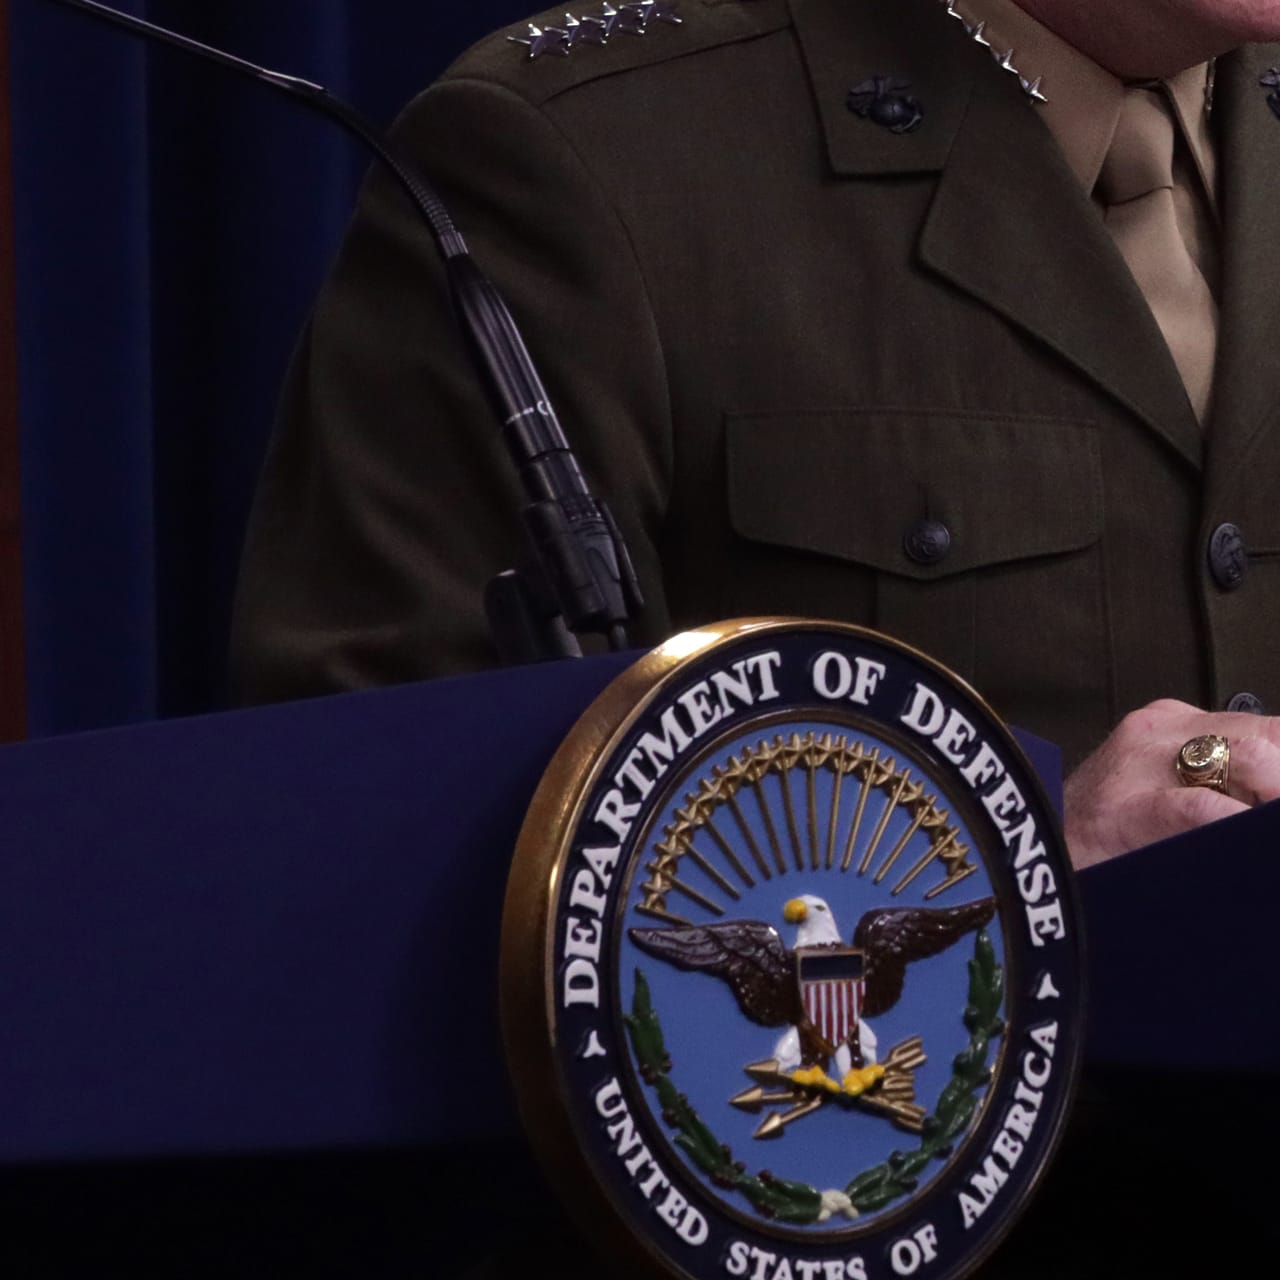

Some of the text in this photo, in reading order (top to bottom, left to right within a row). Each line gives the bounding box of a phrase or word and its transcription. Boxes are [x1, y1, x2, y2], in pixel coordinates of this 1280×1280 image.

[563, 650, 1065, 1008] DEPARTMENT OF DEFENSE
[595, 1021, 1058, 1280] UNITED STATES OF AMERICA
